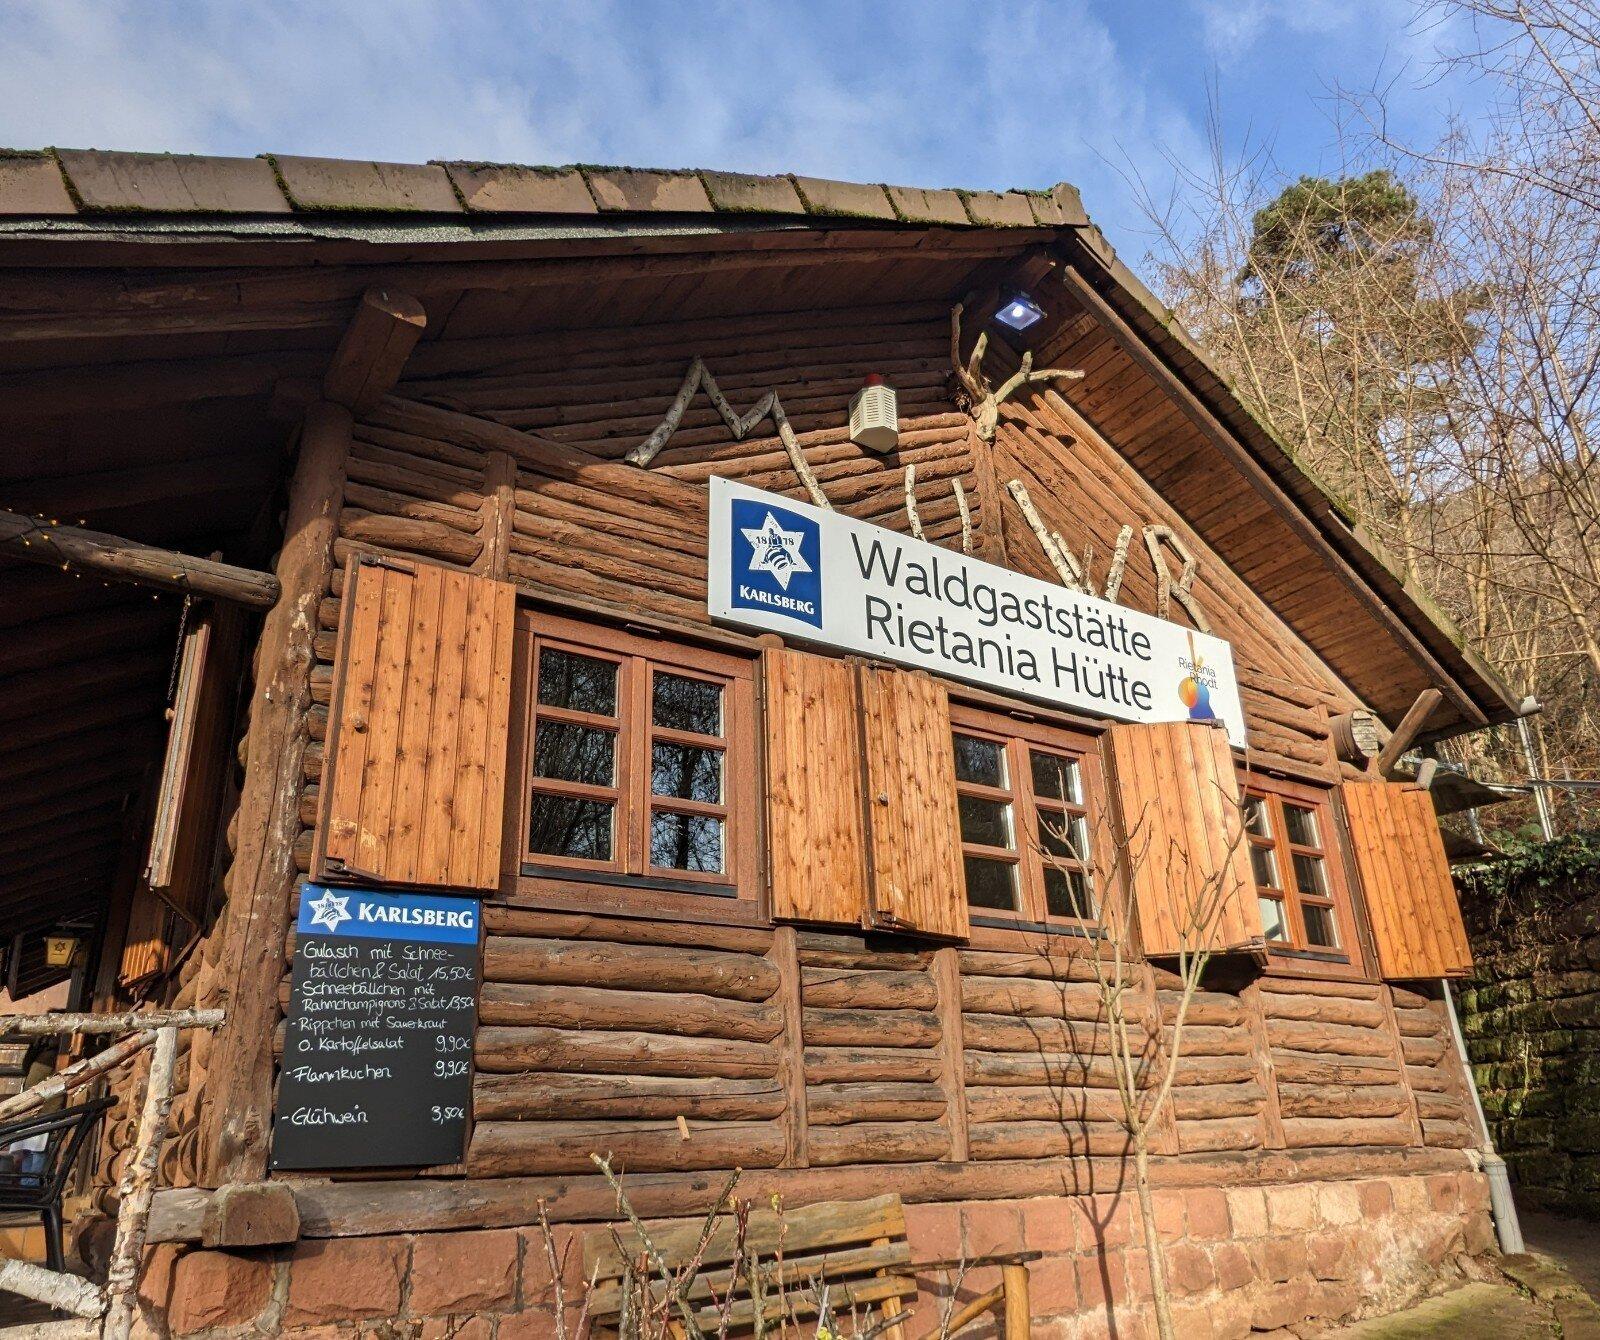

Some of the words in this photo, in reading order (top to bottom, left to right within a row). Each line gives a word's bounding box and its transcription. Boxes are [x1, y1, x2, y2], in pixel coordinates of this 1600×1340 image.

[739, 584, 815, 615] KARLSBERG
[851, 533, 1152, 660] Waldgaststätte
[865, 594, 1041, 683] Rietania
[1051, 647, 1152, 710] Hütte
[358, 903, 474, 929] KARLSBERG
[371, 943, 393, 960] mit
[388, 963, 424, 982] Salat
[414, 982, 436, 996] mit
[418, 996, 447, 1010] Salat
[360, 1017, 380, 1029] mit
[386, 1015, 448, 1029] Sauerkraut
[319, 1035, 405, 1056] Kartoffelsalat
[434, 1035, 472, 1053] 9,90€
[433, 1060, 469, 1079] 9,90€
[431, 1105, 465, 1125] 3,50€
